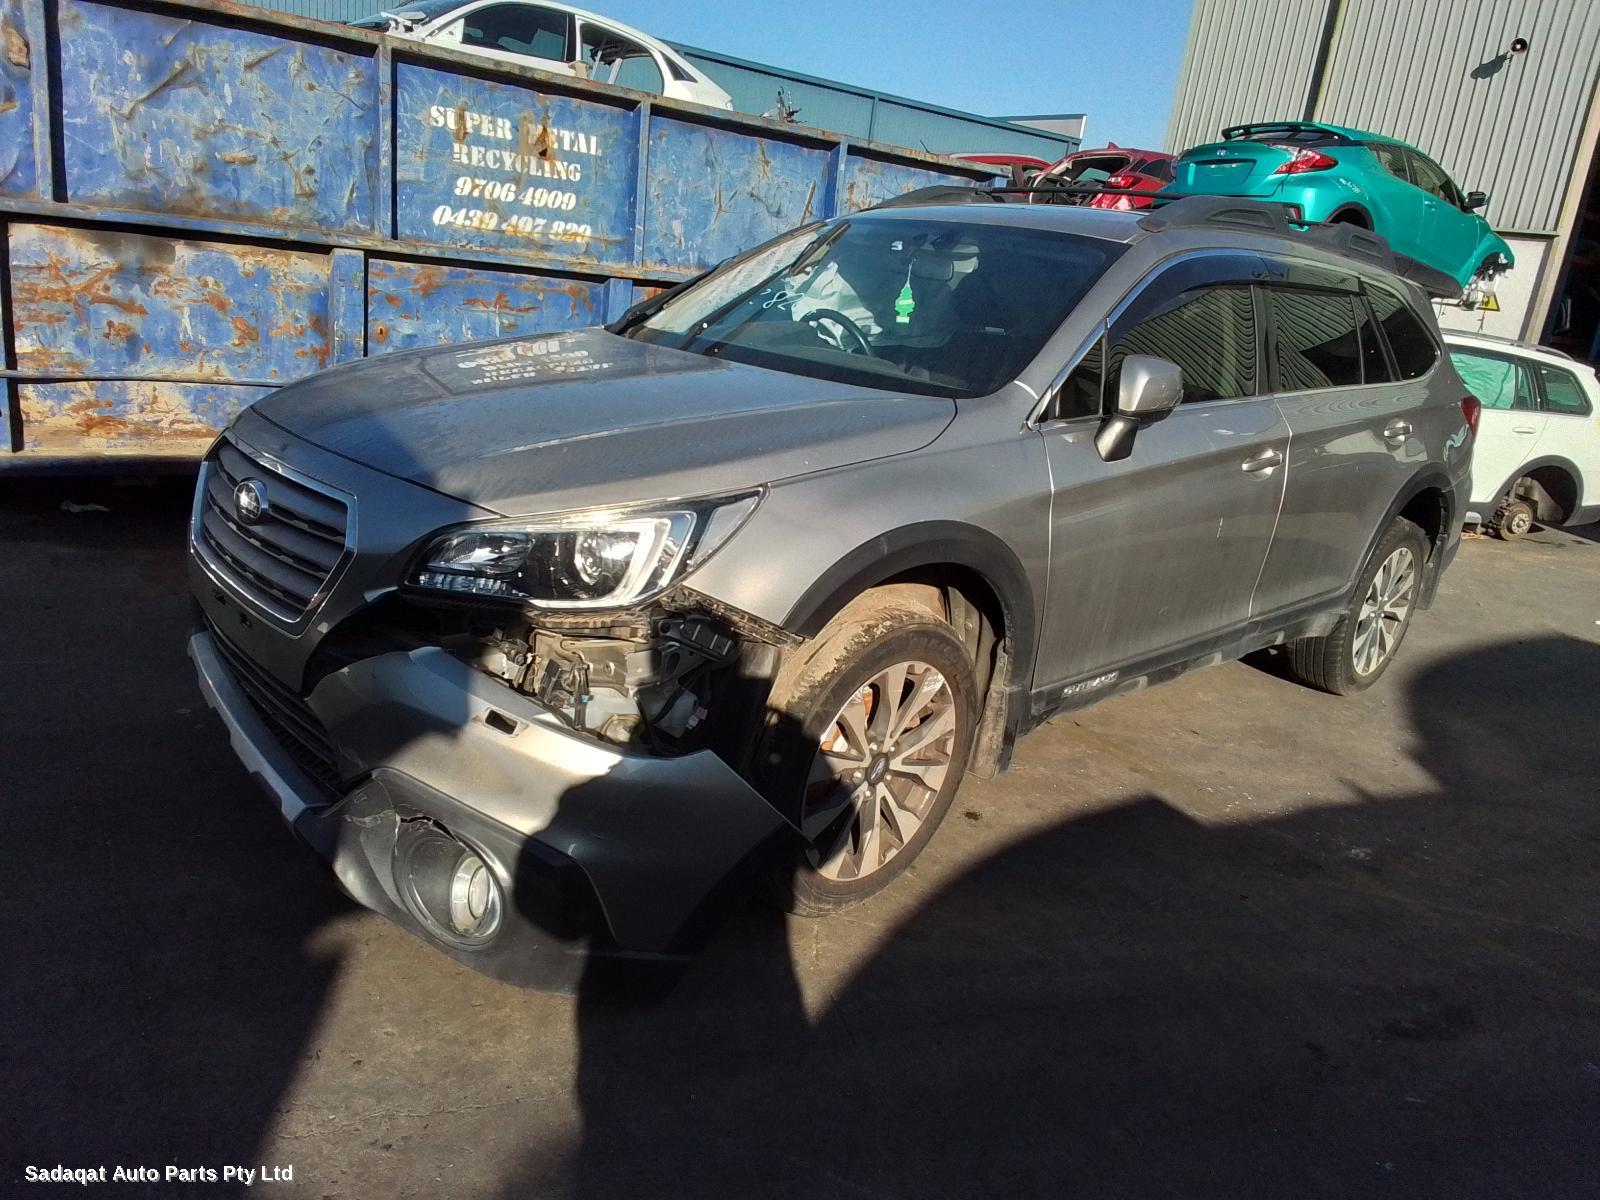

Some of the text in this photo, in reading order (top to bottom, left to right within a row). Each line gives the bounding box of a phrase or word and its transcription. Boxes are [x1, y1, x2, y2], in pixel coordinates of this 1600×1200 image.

[430, 105, 513, 141] SUPER
[452, 142, 581, 182] RECYCLING
[454, 176, 577, 211] 9706 4909
[432, 204, 499, 231] 0439
